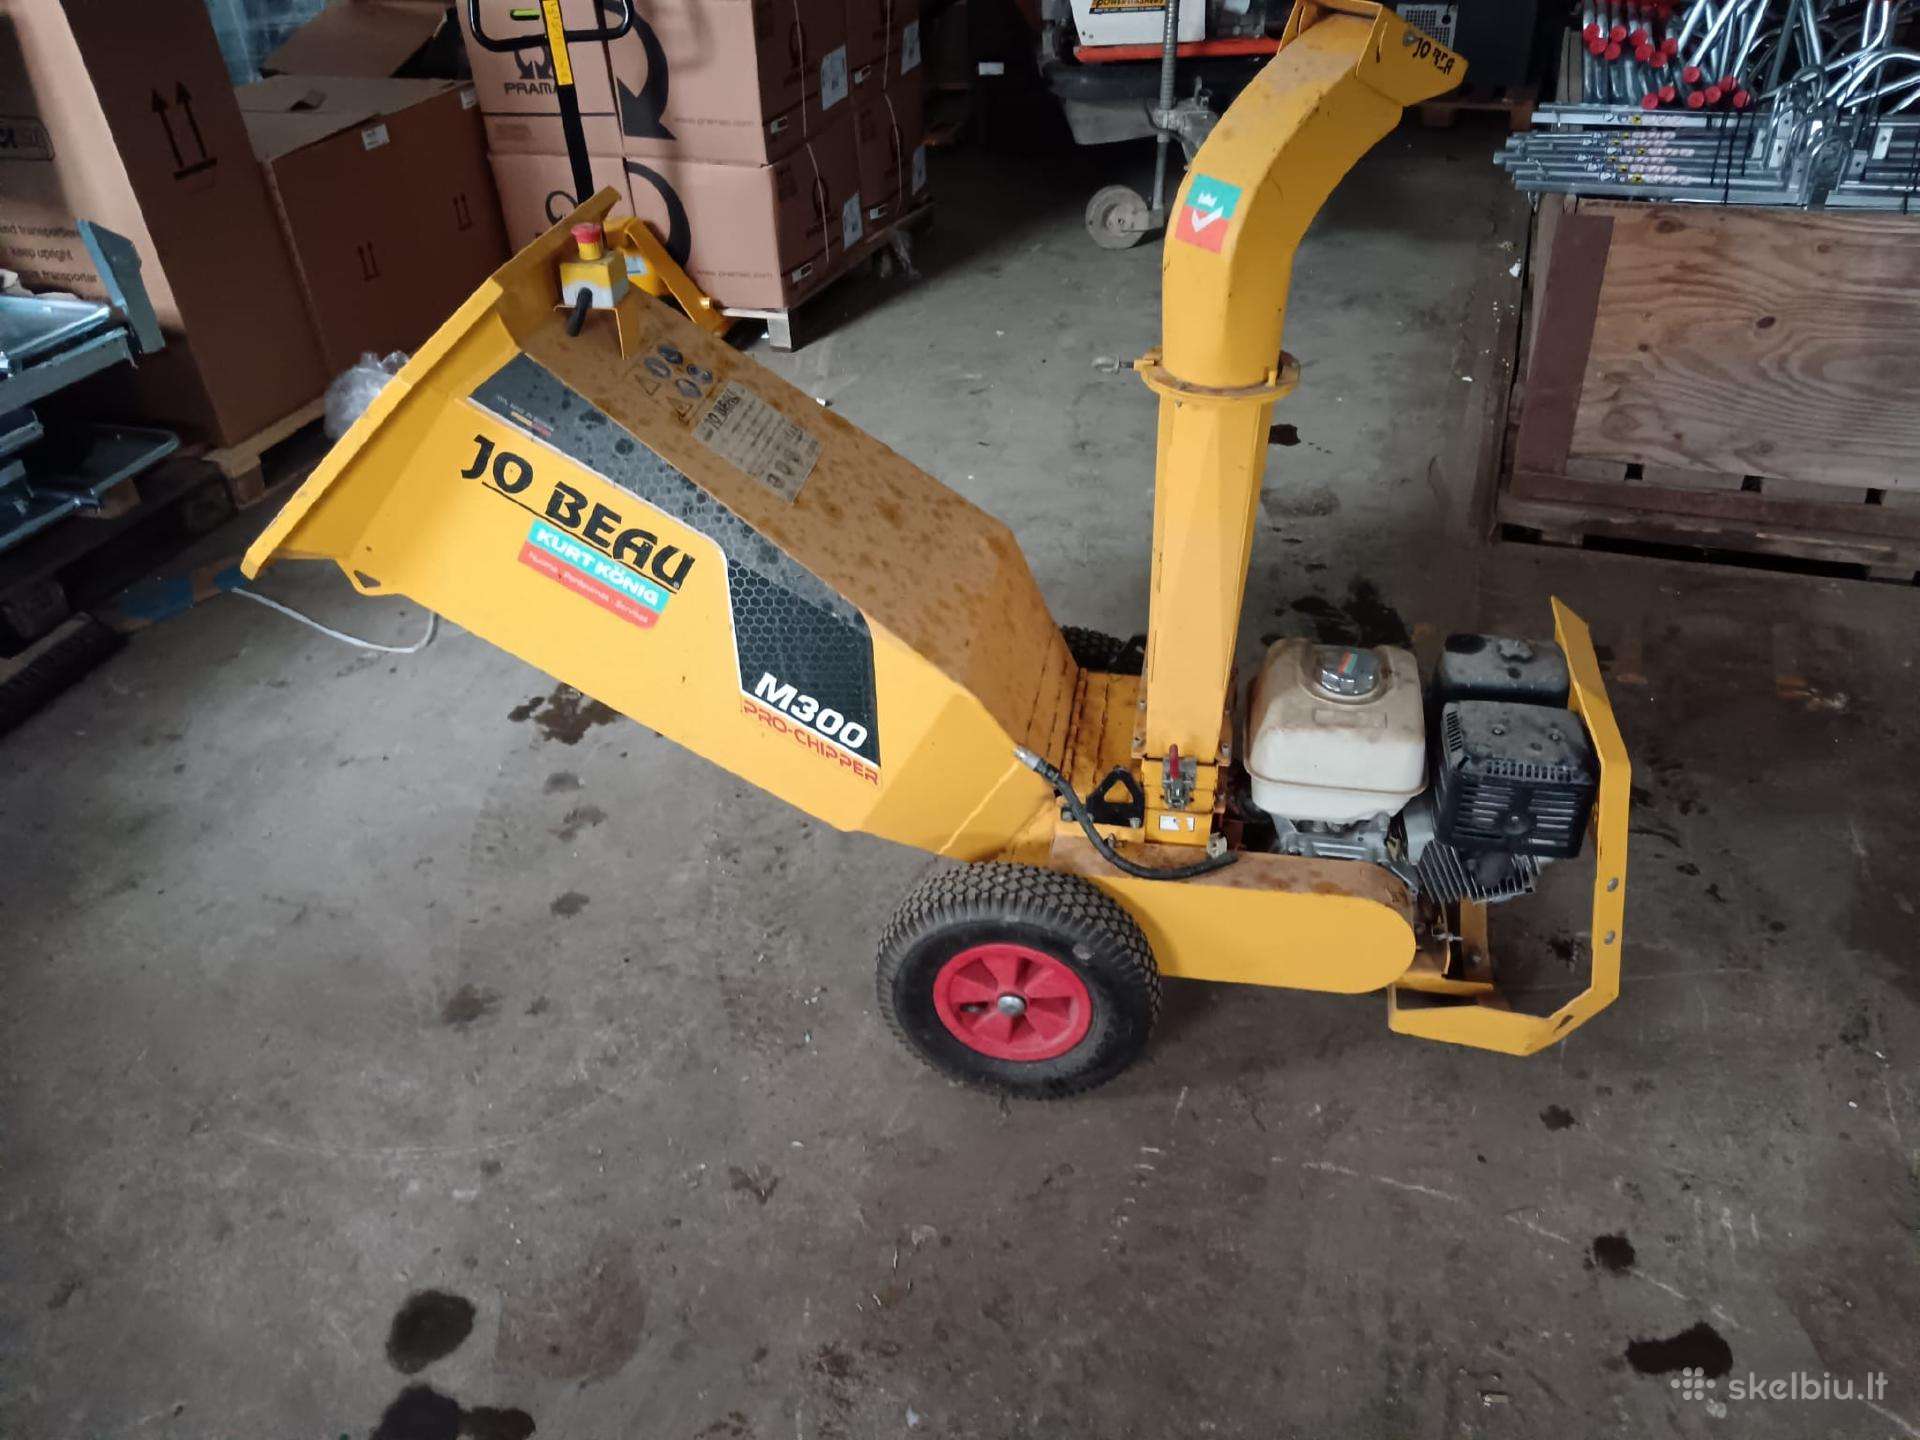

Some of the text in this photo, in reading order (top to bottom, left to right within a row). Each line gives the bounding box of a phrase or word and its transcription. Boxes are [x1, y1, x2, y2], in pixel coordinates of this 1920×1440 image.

[461, 434, 695, 589] JO BEAU
[537, 528, 660, 606] KURT KÖNIG
[743, 699, 879, 786] PRO-CHIPPER
[754, 671, 868, 749] M300
